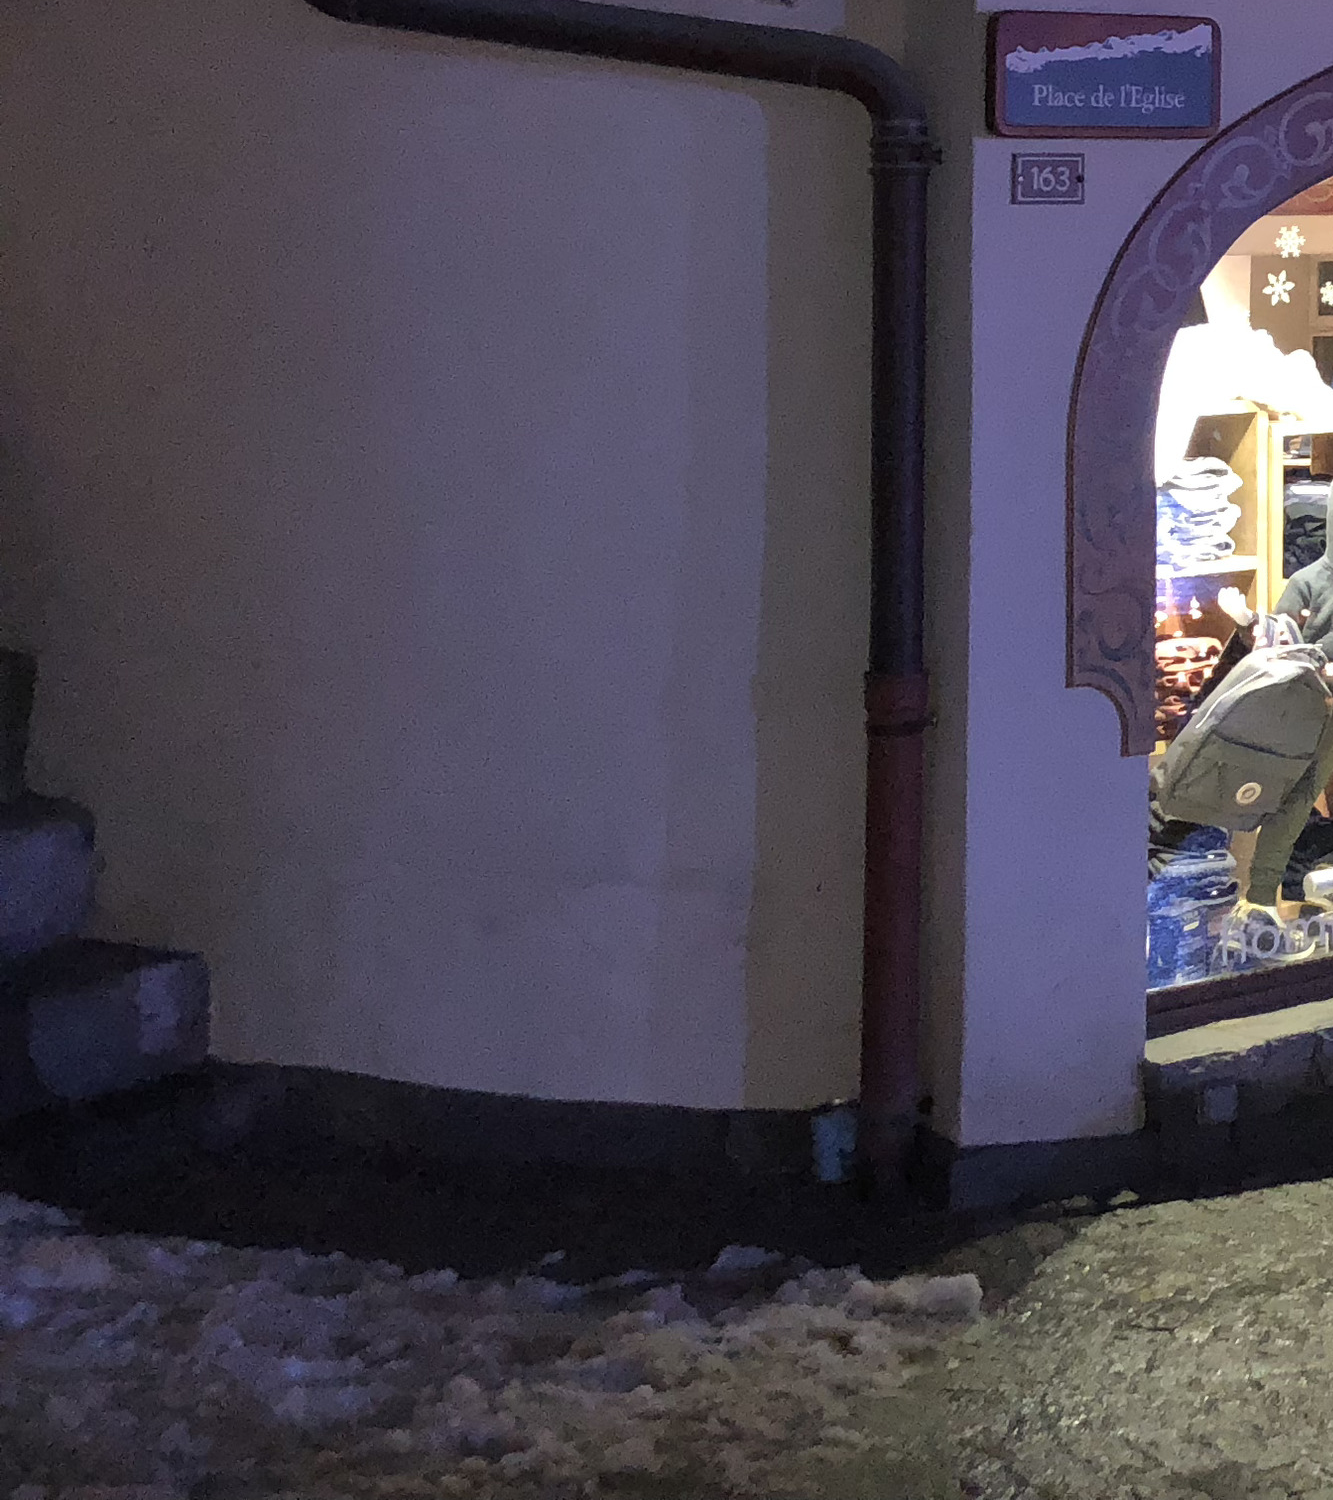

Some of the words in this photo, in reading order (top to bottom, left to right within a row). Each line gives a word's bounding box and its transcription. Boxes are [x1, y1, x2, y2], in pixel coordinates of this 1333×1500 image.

[1031, 84, 1084, 109] Place
[1090, 84, 1115, 109] de
[1119, 83, 1186, 114] l'Eglise
[1030, 165, 1071, 192] 163
